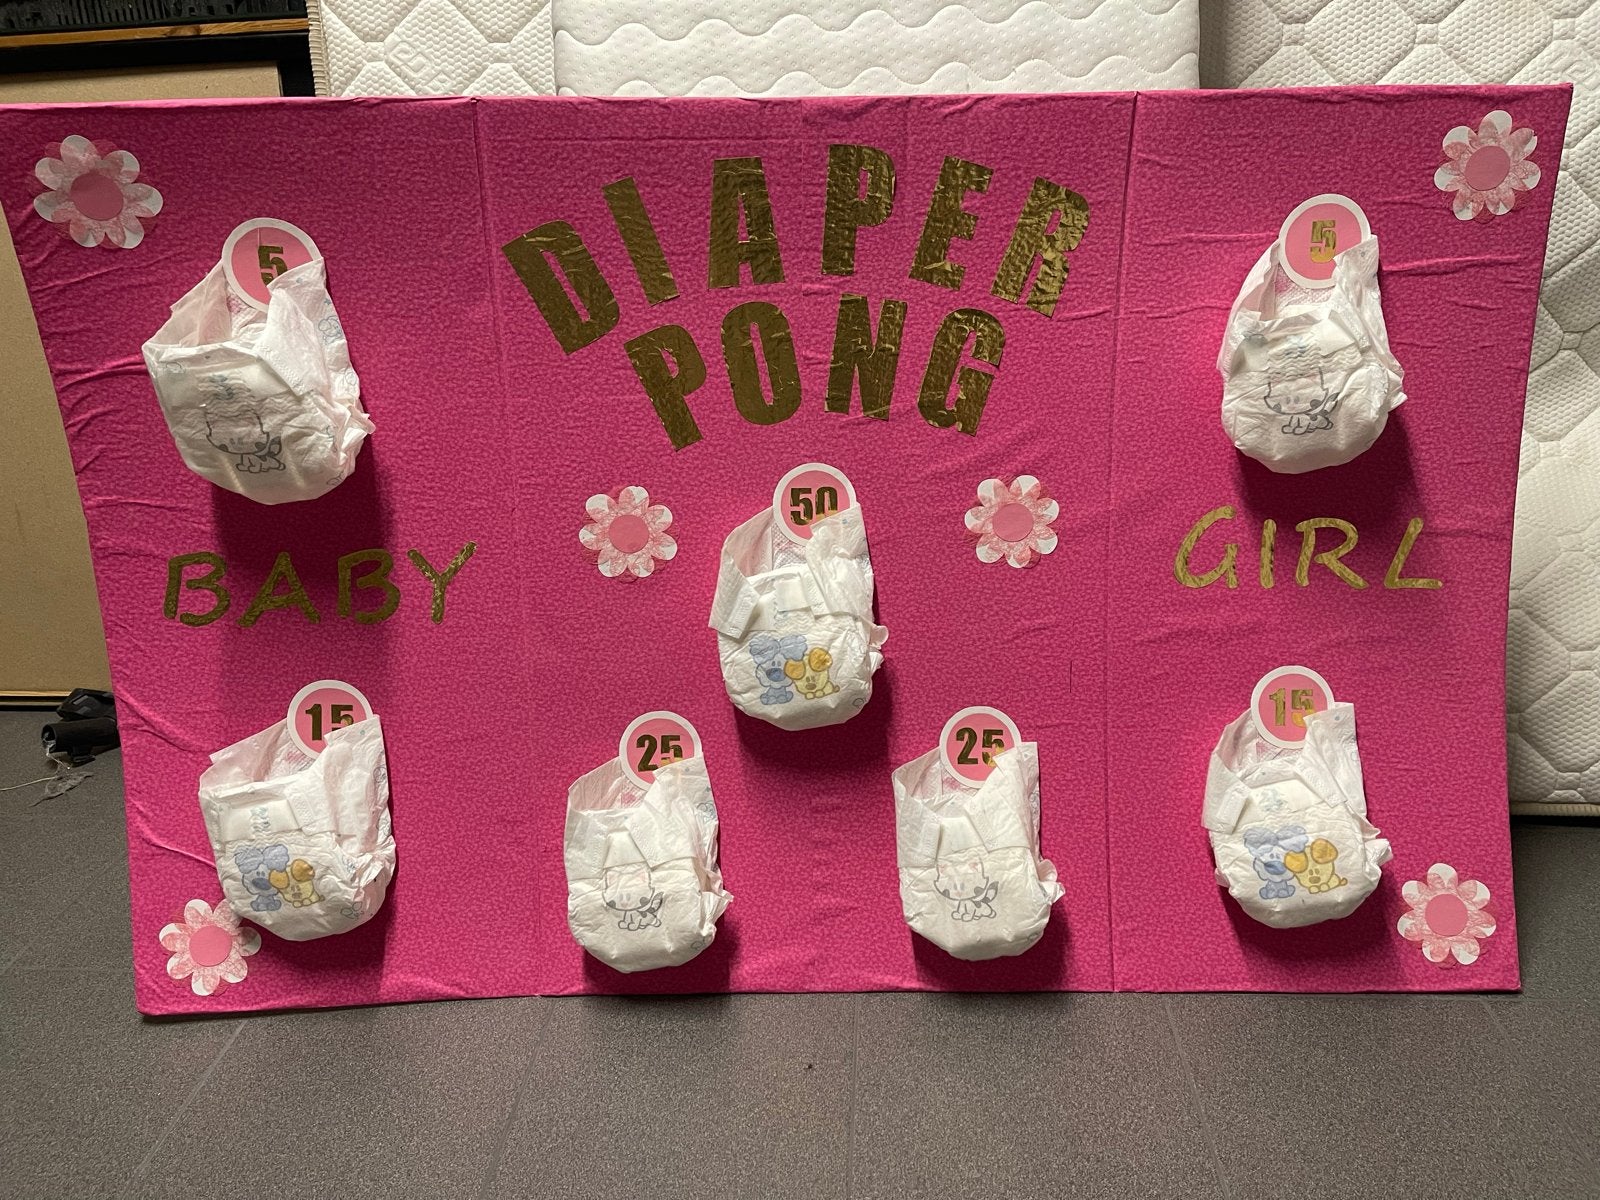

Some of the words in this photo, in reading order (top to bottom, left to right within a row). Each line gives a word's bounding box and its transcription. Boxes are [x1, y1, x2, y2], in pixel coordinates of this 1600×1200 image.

[502, 144, 1091, 354] DIAPER
[1310, 220, 1336, 264] 5
[257, 245, 288, 287] 5
[623, 293, 1006, 452] PONG
[790, 487, 838, 526] 50
[1174, 505, 1443, 589] GIRL
[164, 541, 477, 627] BABY
[305, 703, 354, 742] 15
[1268, 687, 1314, 728] 15
[636, 734, 683, 773] 25
[956, 727, 1005, 768] 25
